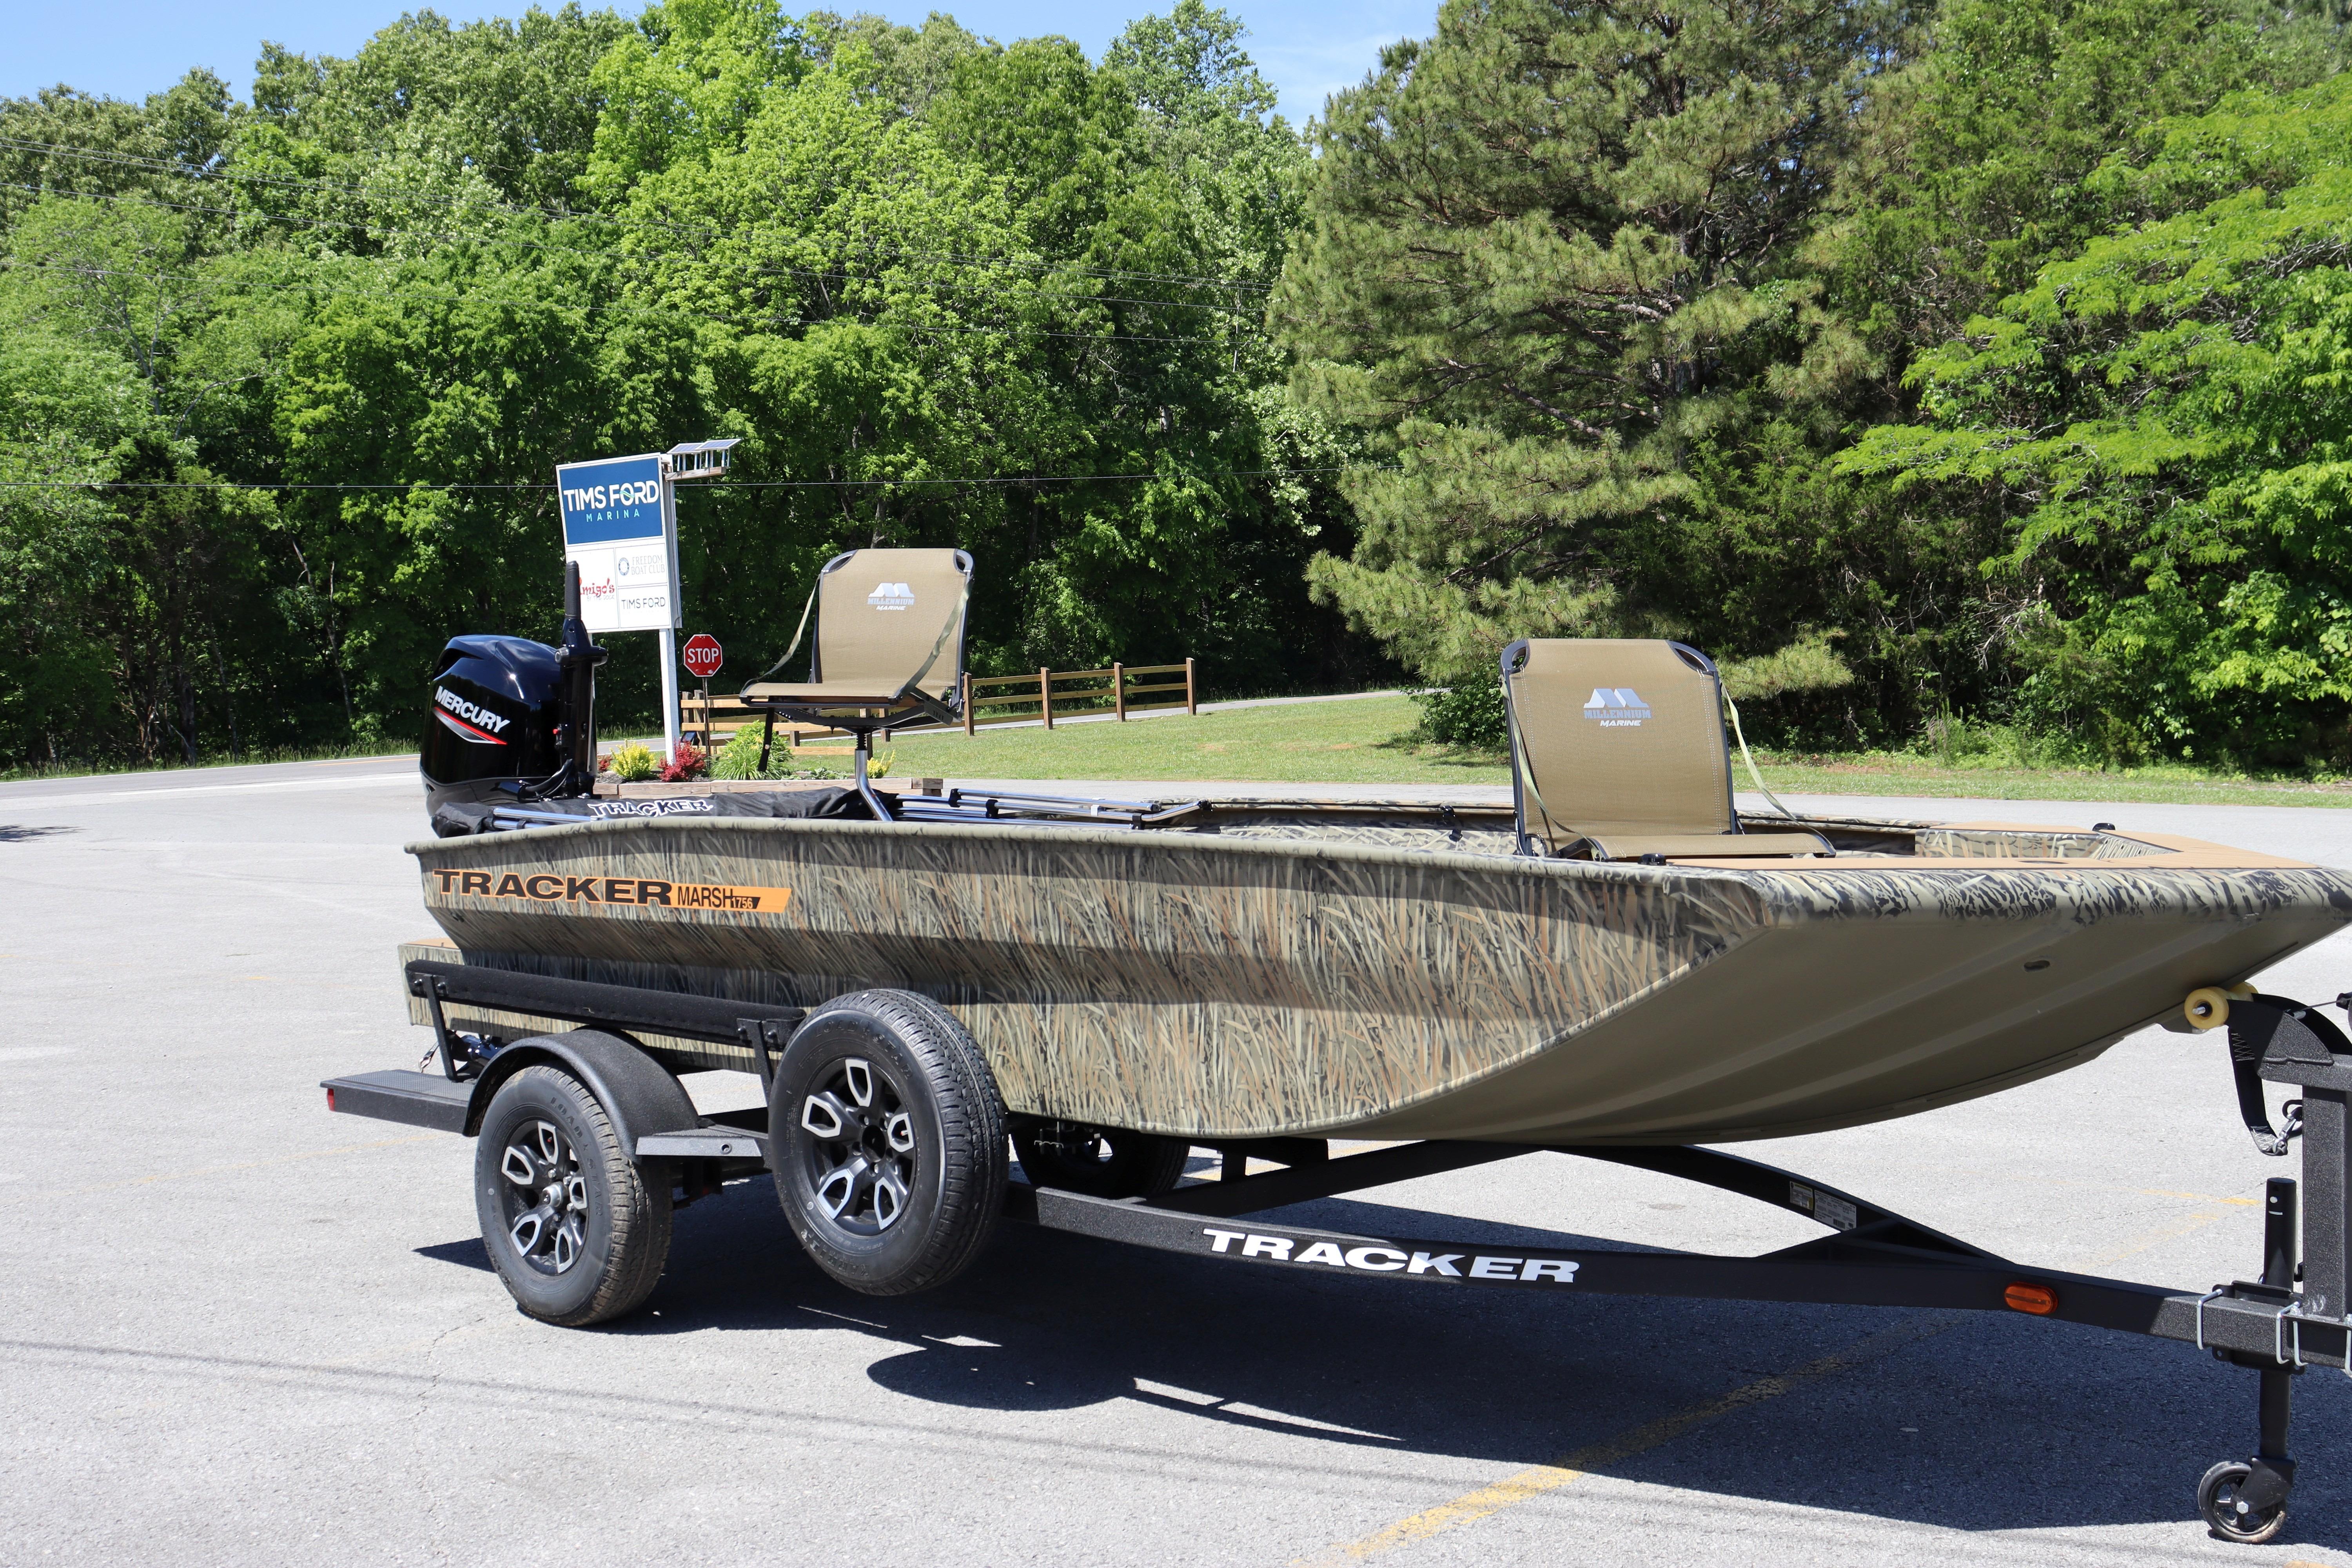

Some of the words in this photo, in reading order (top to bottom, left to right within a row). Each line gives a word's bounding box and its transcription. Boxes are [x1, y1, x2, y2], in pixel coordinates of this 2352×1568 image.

[563, 485, 606, 511] TIMS
[608, 480, 659, 507] FORD
[586, 508, 640, 522] MARINA
[632, 555, 662, 565] FREEDOM
[631, 565, 647, 575] BOAT
[648, 564, 665, 573] CLUB
[621, 599, 641, 610] TIMS
[642, 597, 666, 608] FORD
[687, 648, 719, 664] STOP
[435, 685, 510, 733] MERCURY
[1584, 710, 1652, 719] MILLENNIUM
[588, 799, 713, 817] TRACKER
[433, 869, 672, 906] TRACKER
[678, 886, 733, 908] MARSH
[731, 897, 753, 909] 1756
[815, 1020, 858, 1038] LOAD
[550, 1097, 583, 1138] LOAD
[1203, 1228, 1579, 1283] TRACKER
